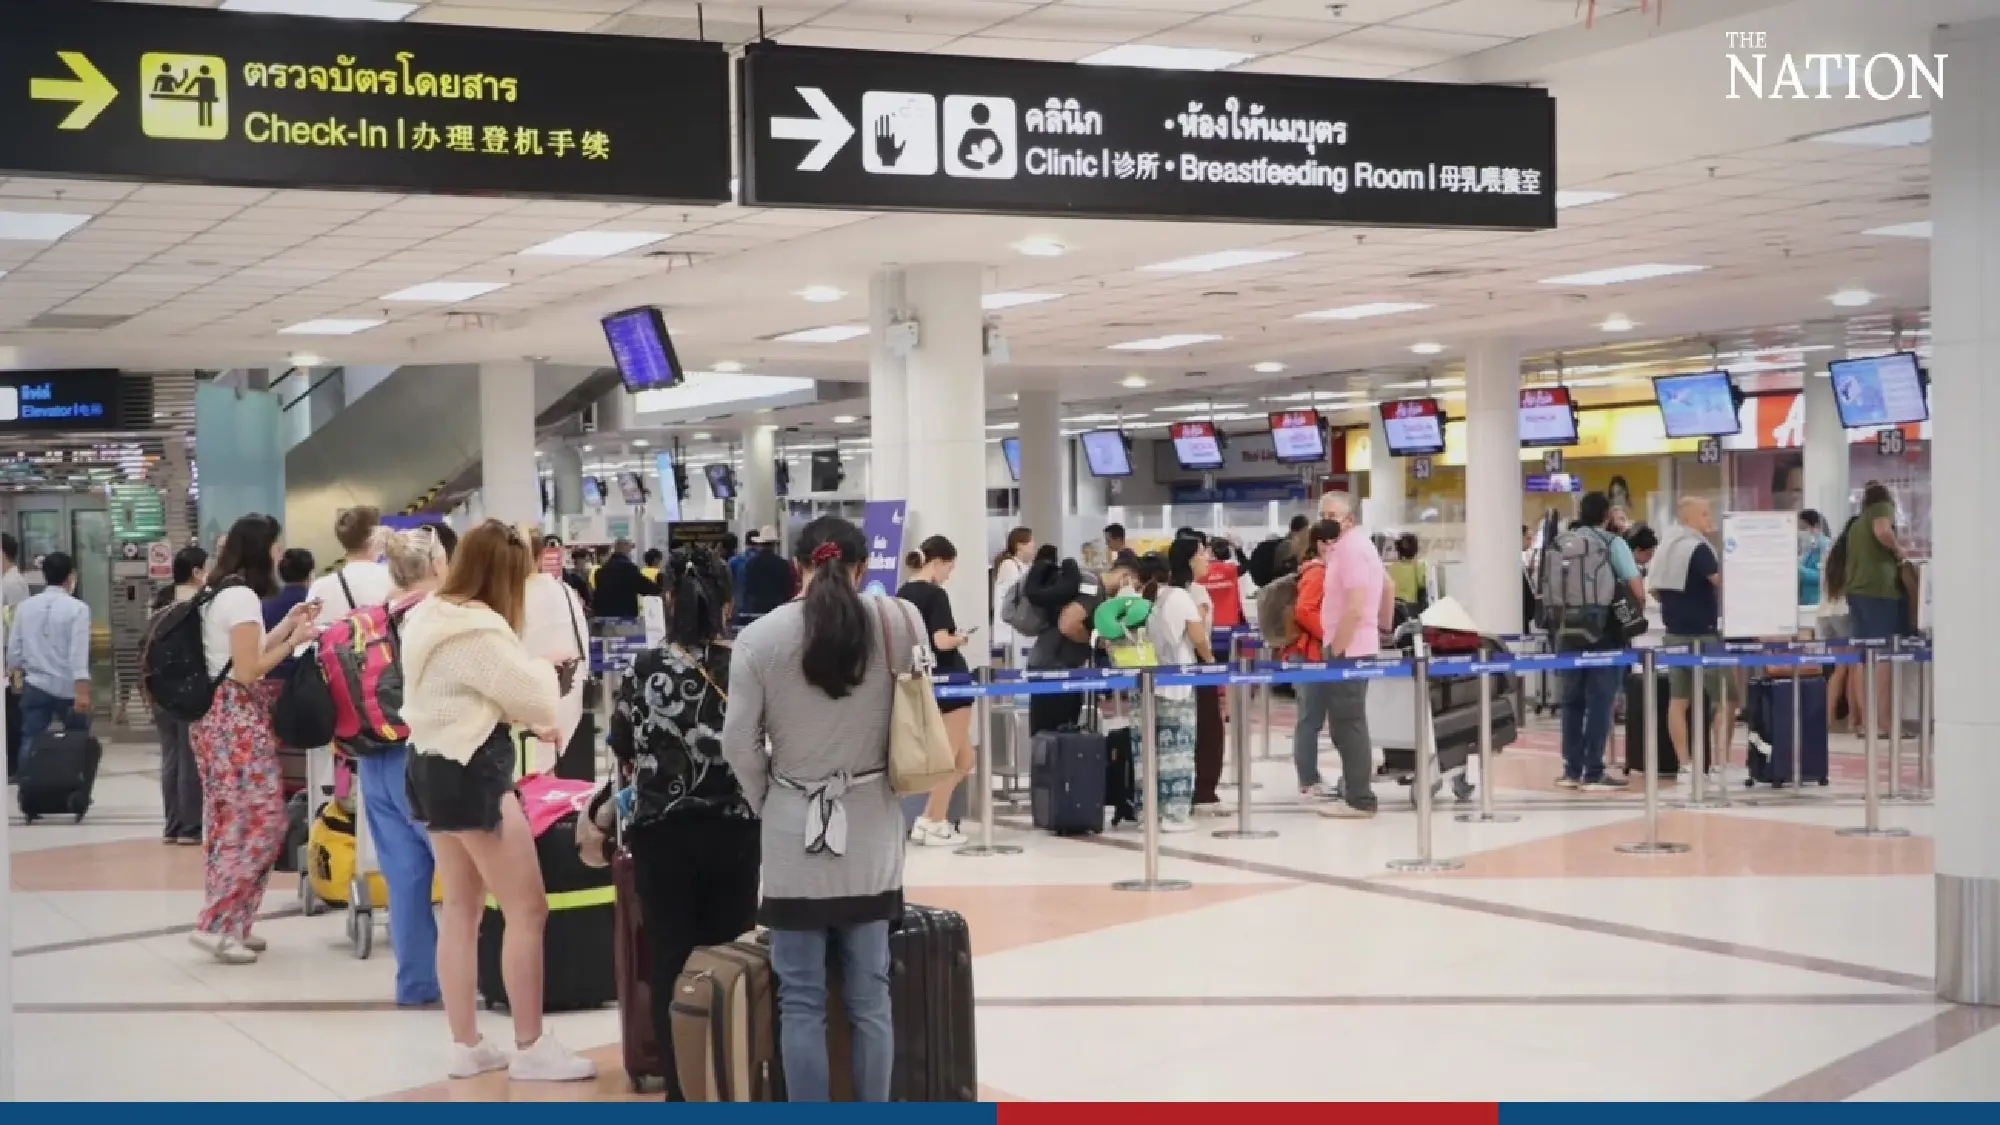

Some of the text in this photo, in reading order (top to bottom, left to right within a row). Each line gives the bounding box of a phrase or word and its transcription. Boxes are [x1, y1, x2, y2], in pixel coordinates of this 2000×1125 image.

[242, 51, 518, 103] ตรวจบัตรโดยสาร
[244, 111, 610, 160] Check-In 办理登机手续
[1025, 97, 1103, 137] คลินิก
[1178, 97, 1348, 155] ห้องให้นมบุตร
[1025, 146, 1098, 177] Clinic
[1111, 150, 1159, 181] 诊所
[1180, 154, 1348, 194] Breastfeeding
[1354, 161, 1426, 190] Room
[1700, 440, 1719, 462] 55
[1879, 431, 1903, 454] 56
